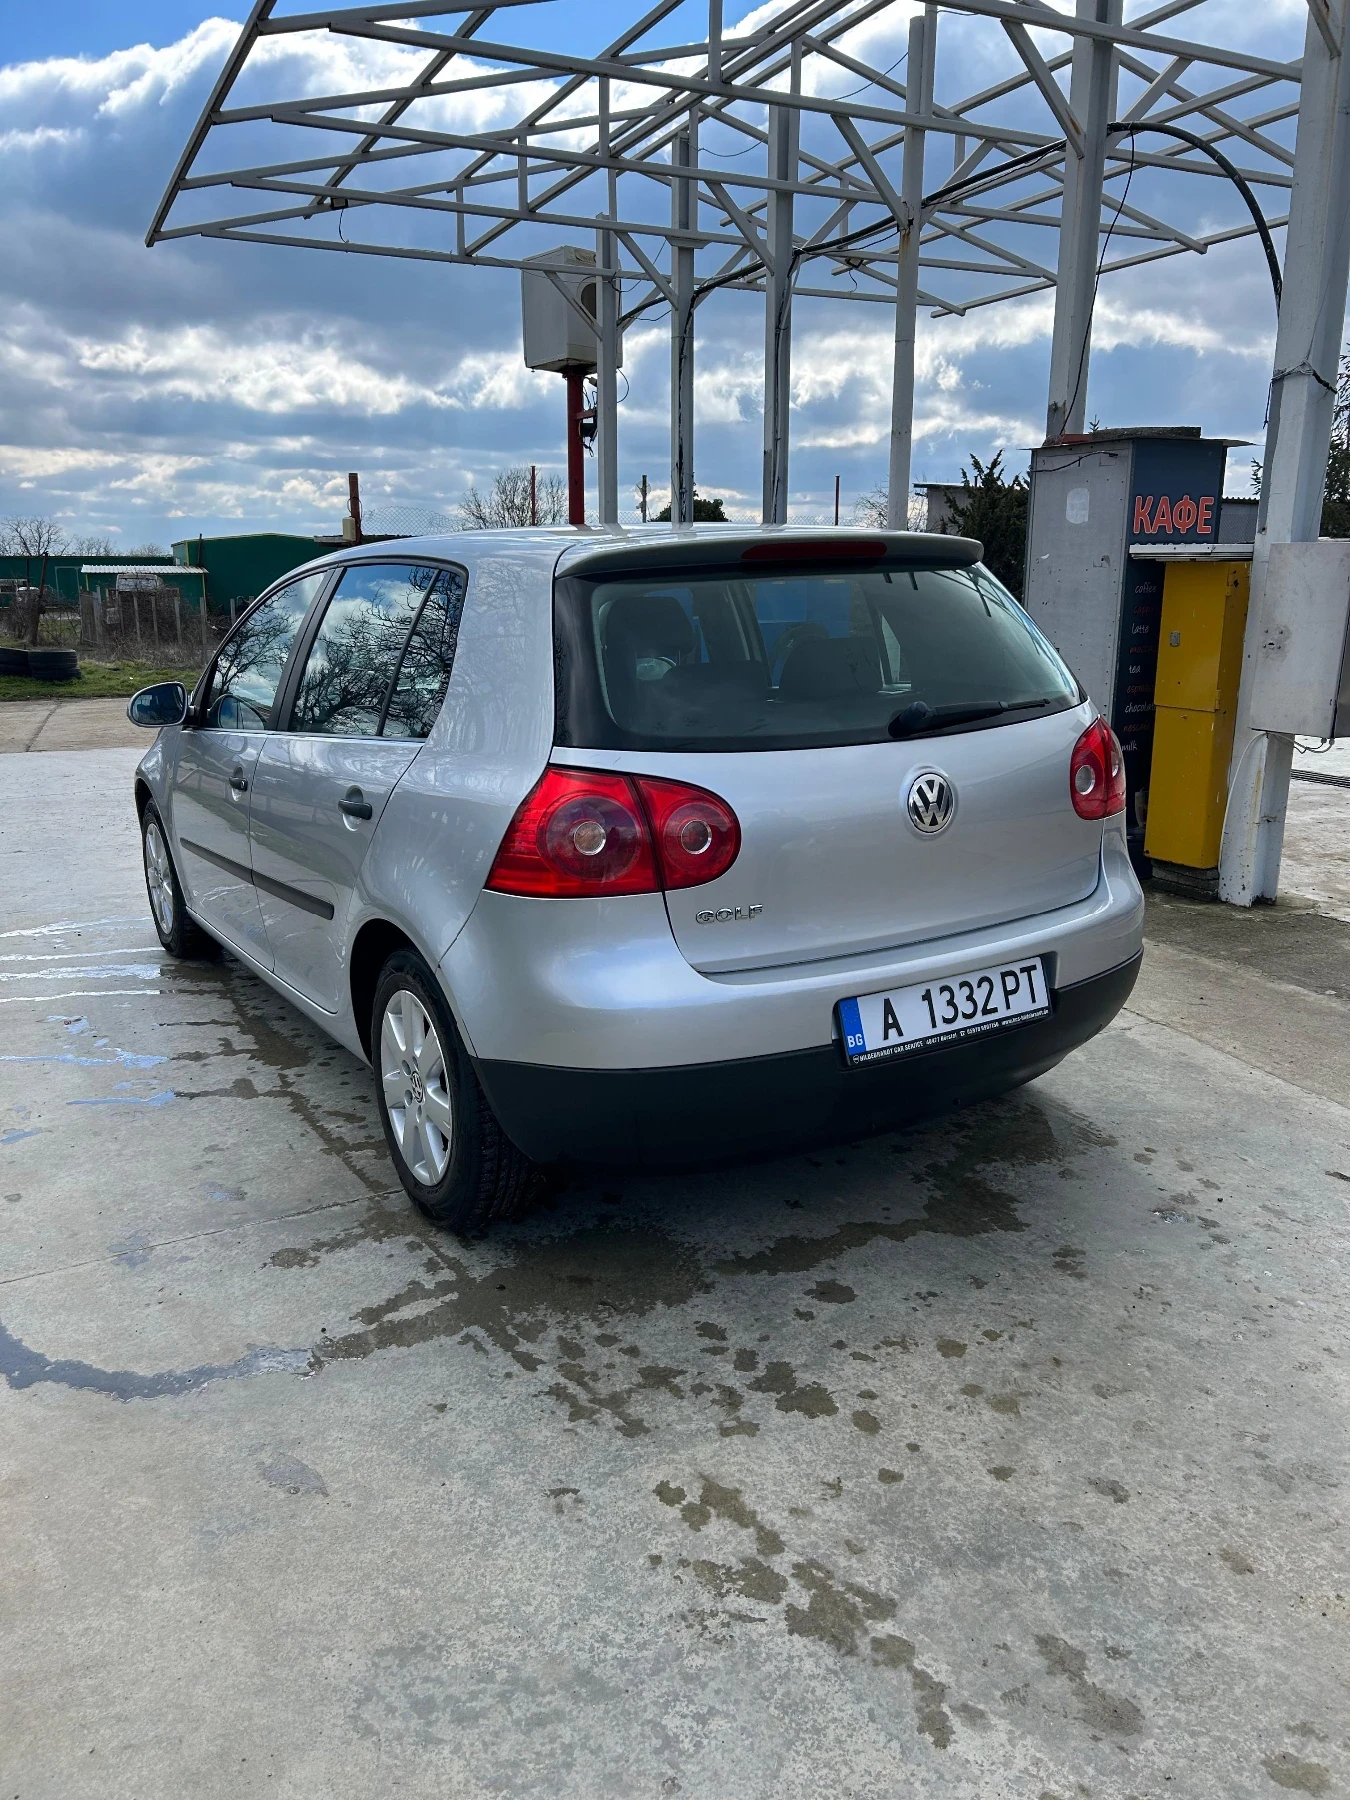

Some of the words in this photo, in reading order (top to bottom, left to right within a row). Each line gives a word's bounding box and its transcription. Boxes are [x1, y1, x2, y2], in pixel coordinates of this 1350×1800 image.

[1133, 494, 1214, 534] КАФЕ
[1134, 581, 1157, 594] coffee
[1128, 664, 1141, 674] tea
[696, 904, 763, 924] GOLF
[882, 997, 904, 1041] A
[847, 1033, 864, 1048] BG
